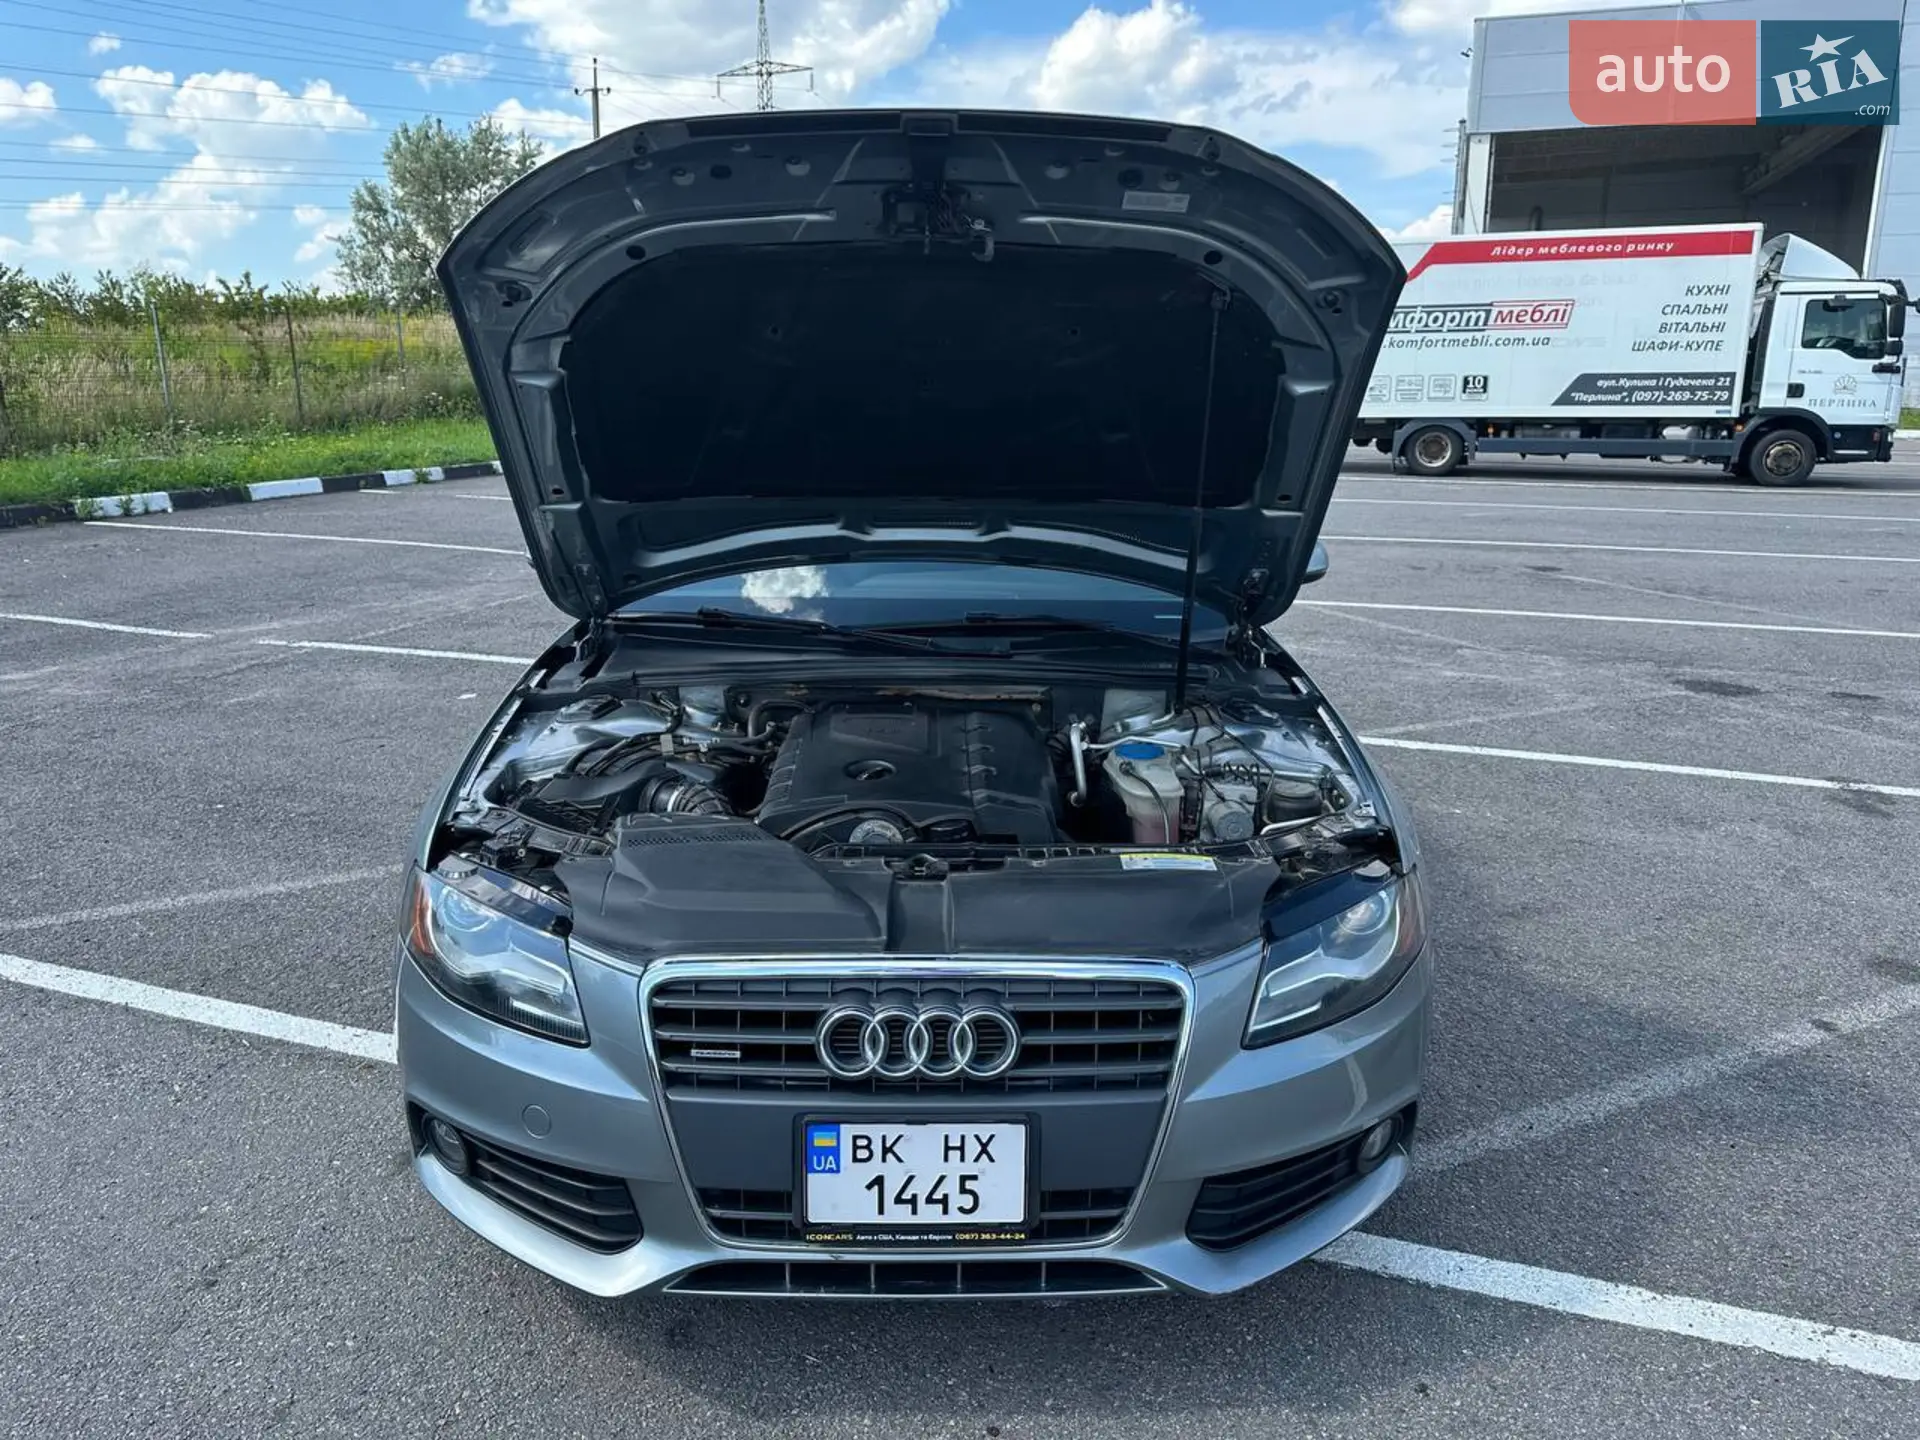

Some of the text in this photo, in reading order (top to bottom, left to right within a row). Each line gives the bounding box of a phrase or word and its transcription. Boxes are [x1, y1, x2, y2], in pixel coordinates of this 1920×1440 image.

[1491, 241, 1675, 257] Лідер меблевого ринку
[1684, 284, 1731, 296] КУХНІ
[1493, 303, 1569, 324] меблі
[1661, 303, 1729, 316] СПАЛЬНІ
[1658, 321, 1726, 334] ВІТАЛЬНІ
[1631, 340, 1724, 352] ШАФИ-КУПЕ
[1466, 375, 1485, 388] 10
[1716, 376, 1731, 387] 21
[1632, 390, 1730, 404] (097)-269-75-79
[1807, 398, 1877, 408] ПЕРЛИНА
[851, 1133, 997, 1164] BK HX
[813, 1155, 837, 1171] UA
[864, 1174, 981, 1216] 1445
